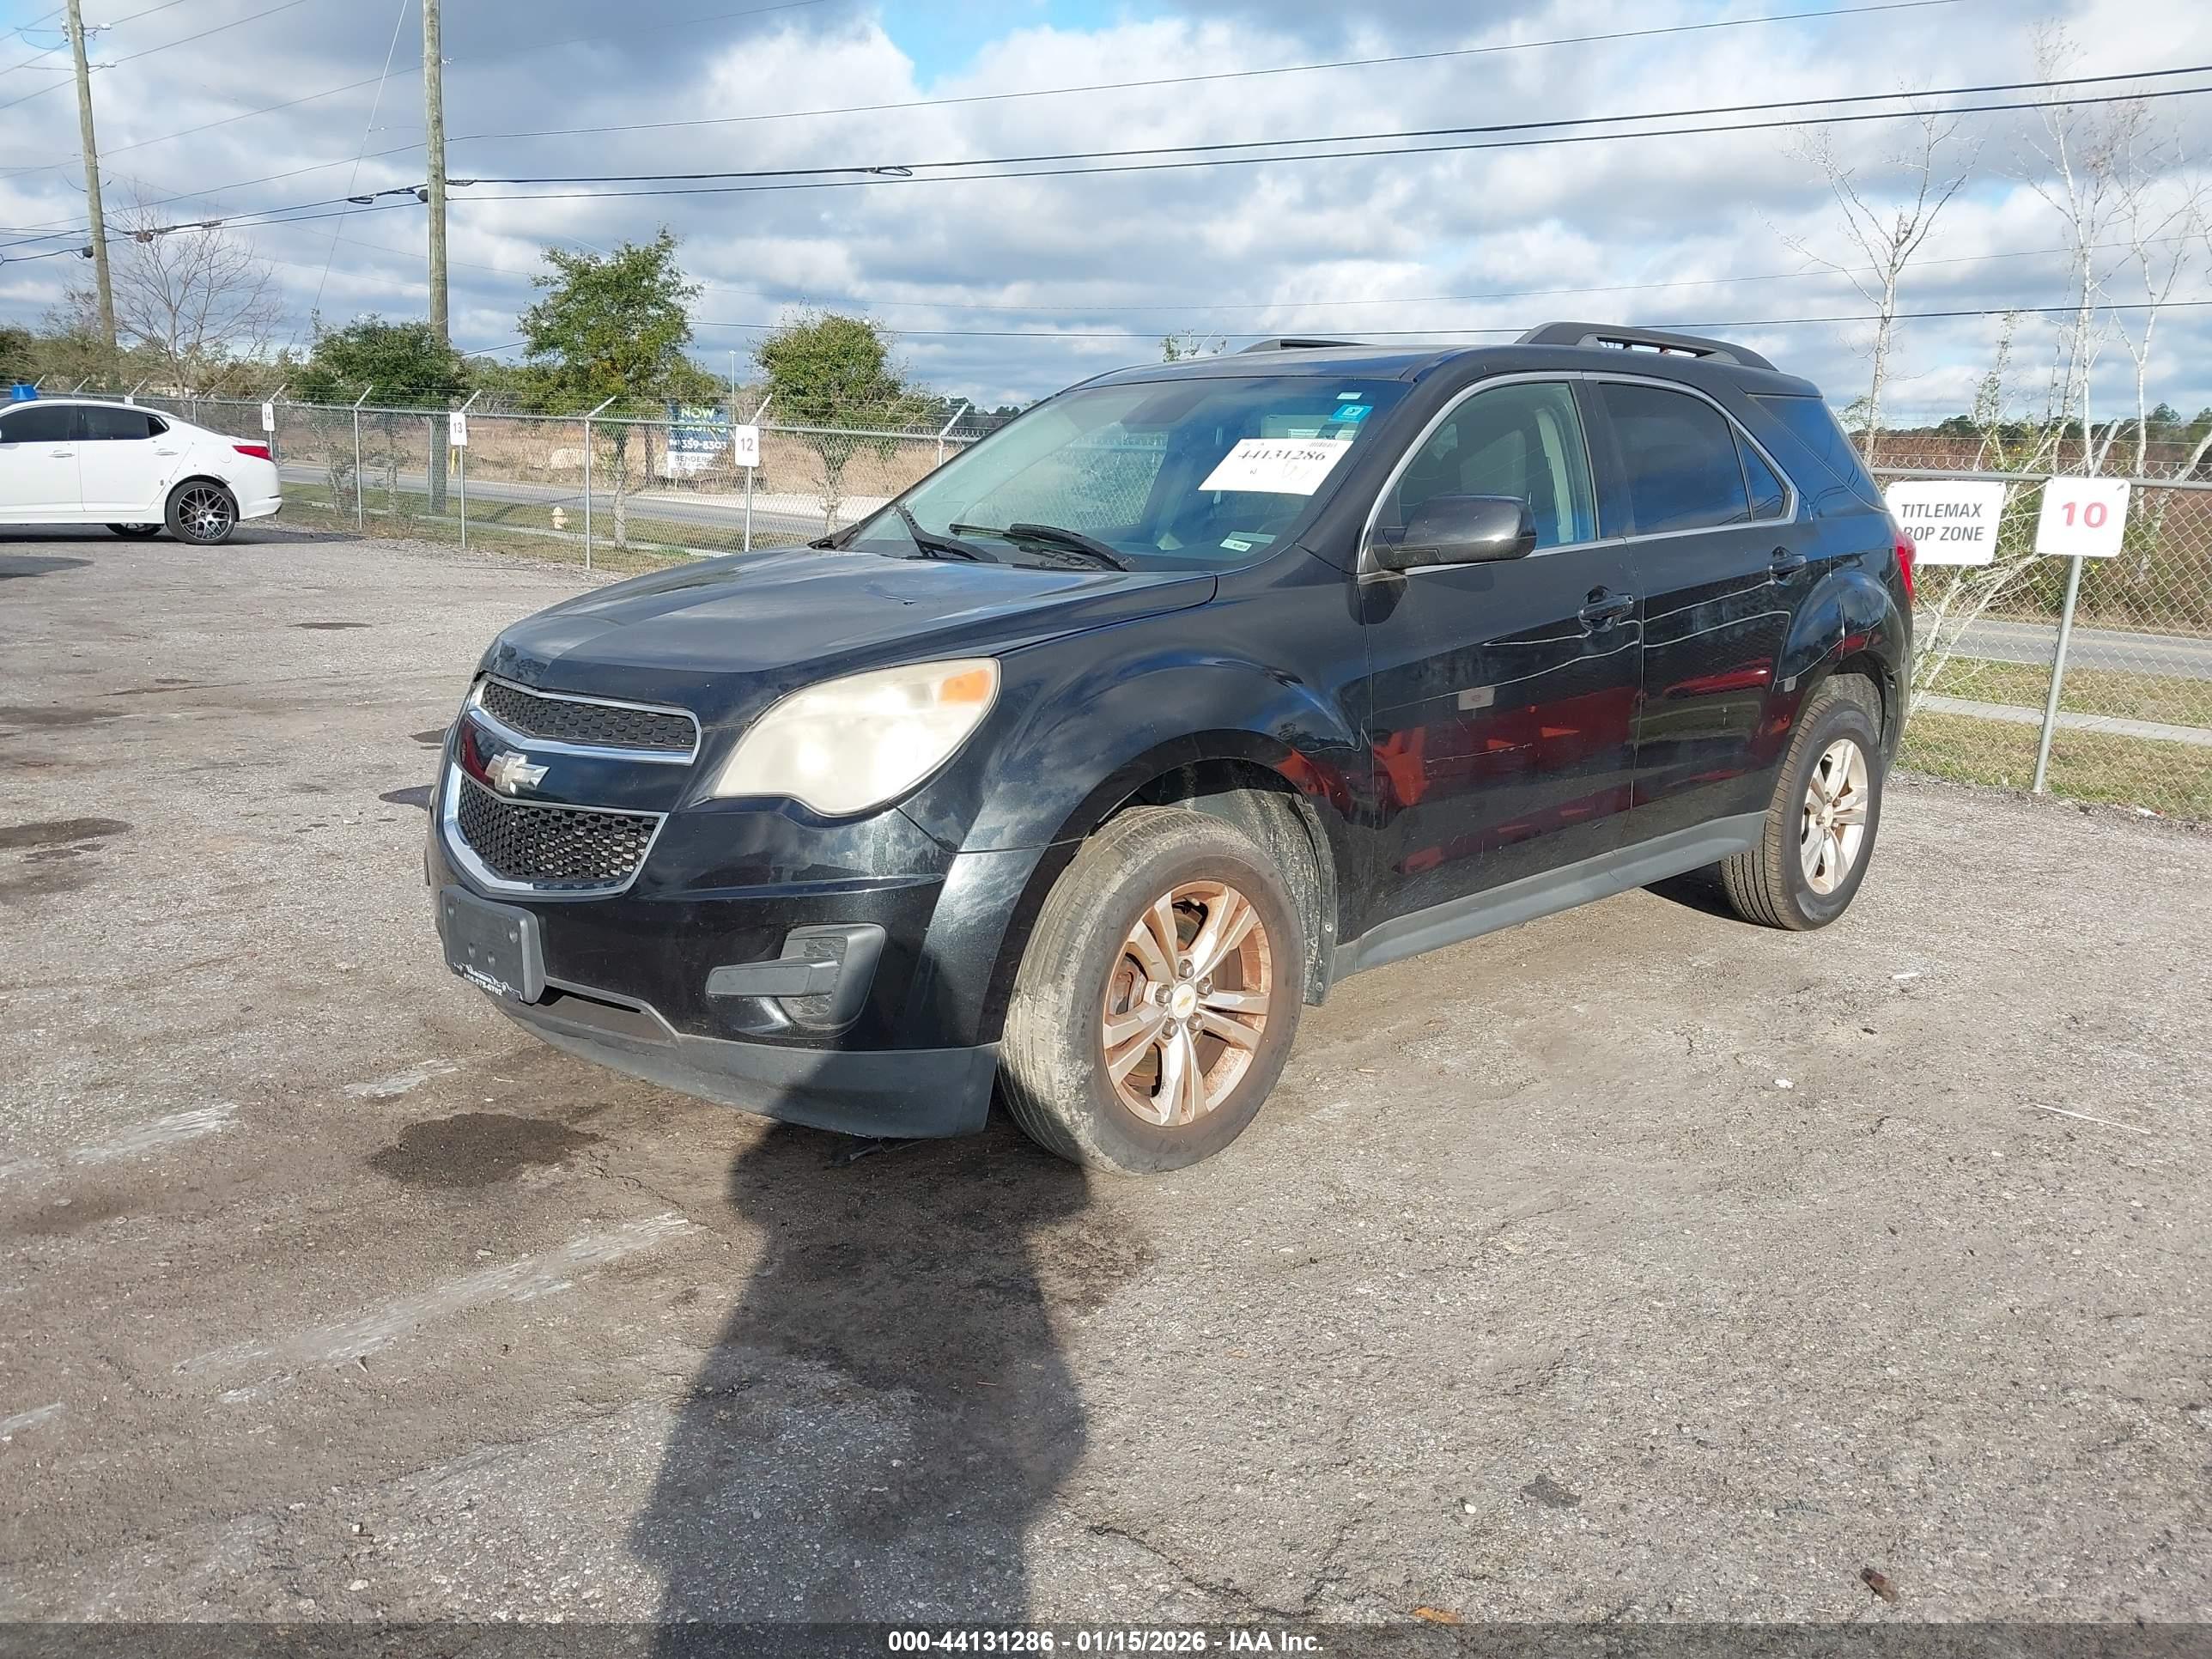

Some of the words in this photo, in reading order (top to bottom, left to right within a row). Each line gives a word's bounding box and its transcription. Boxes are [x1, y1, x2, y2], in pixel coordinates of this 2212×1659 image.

[681, 407, 715, 419] NOW
[453, 422, 463, 434] 13
[741, 437, 754, 452] 12
[1237, 449, 1327, 461] 44131286
[1900, 503, 1984, 519] TITLEMAX
[2062, 501, 2108, 528] 10
[1904, 526, 1936, 541] ROP
[1940, 526, 1985, 541] ZONE
